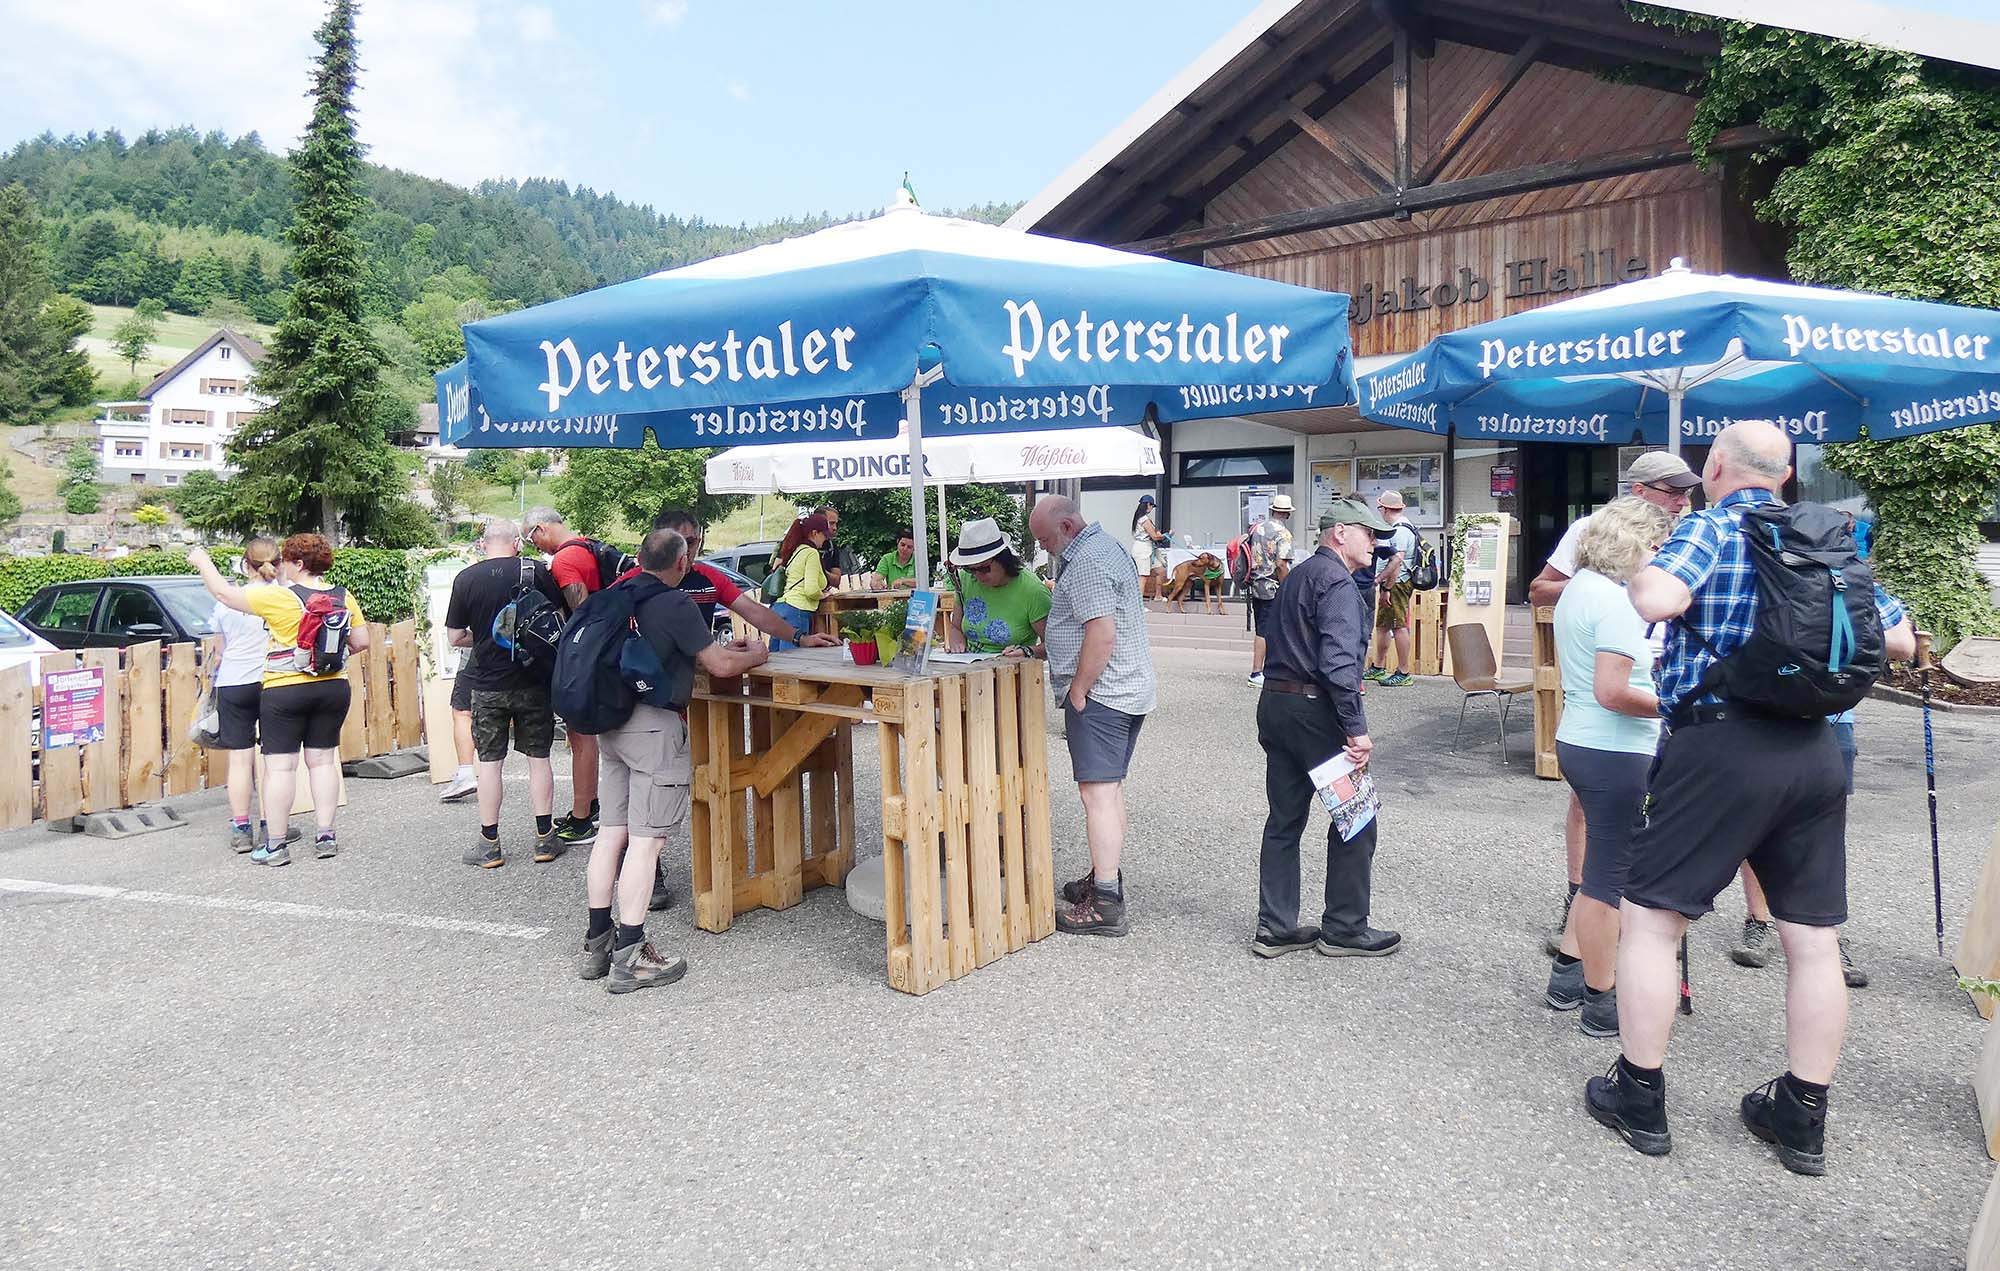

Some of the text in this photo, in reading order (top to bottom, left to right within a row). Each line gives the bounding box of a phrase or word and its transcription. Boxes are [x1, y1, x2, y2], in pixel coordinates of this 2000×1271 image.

[1505, 248, 1649, 300] Halle
[1002, 299, 1291, 379] Peterstaler
[1477, 326, 1686, 379] Peterstaler
[1781, 313, 1991, 361] Peterstaler
[538, 319, 856, 413] Peterstaler
[1368, 361, 1427, 410] Peterstaler
[811, 453, 933, 481] ERDINGER
[1020, 444, 1088, 472] Weißbier
